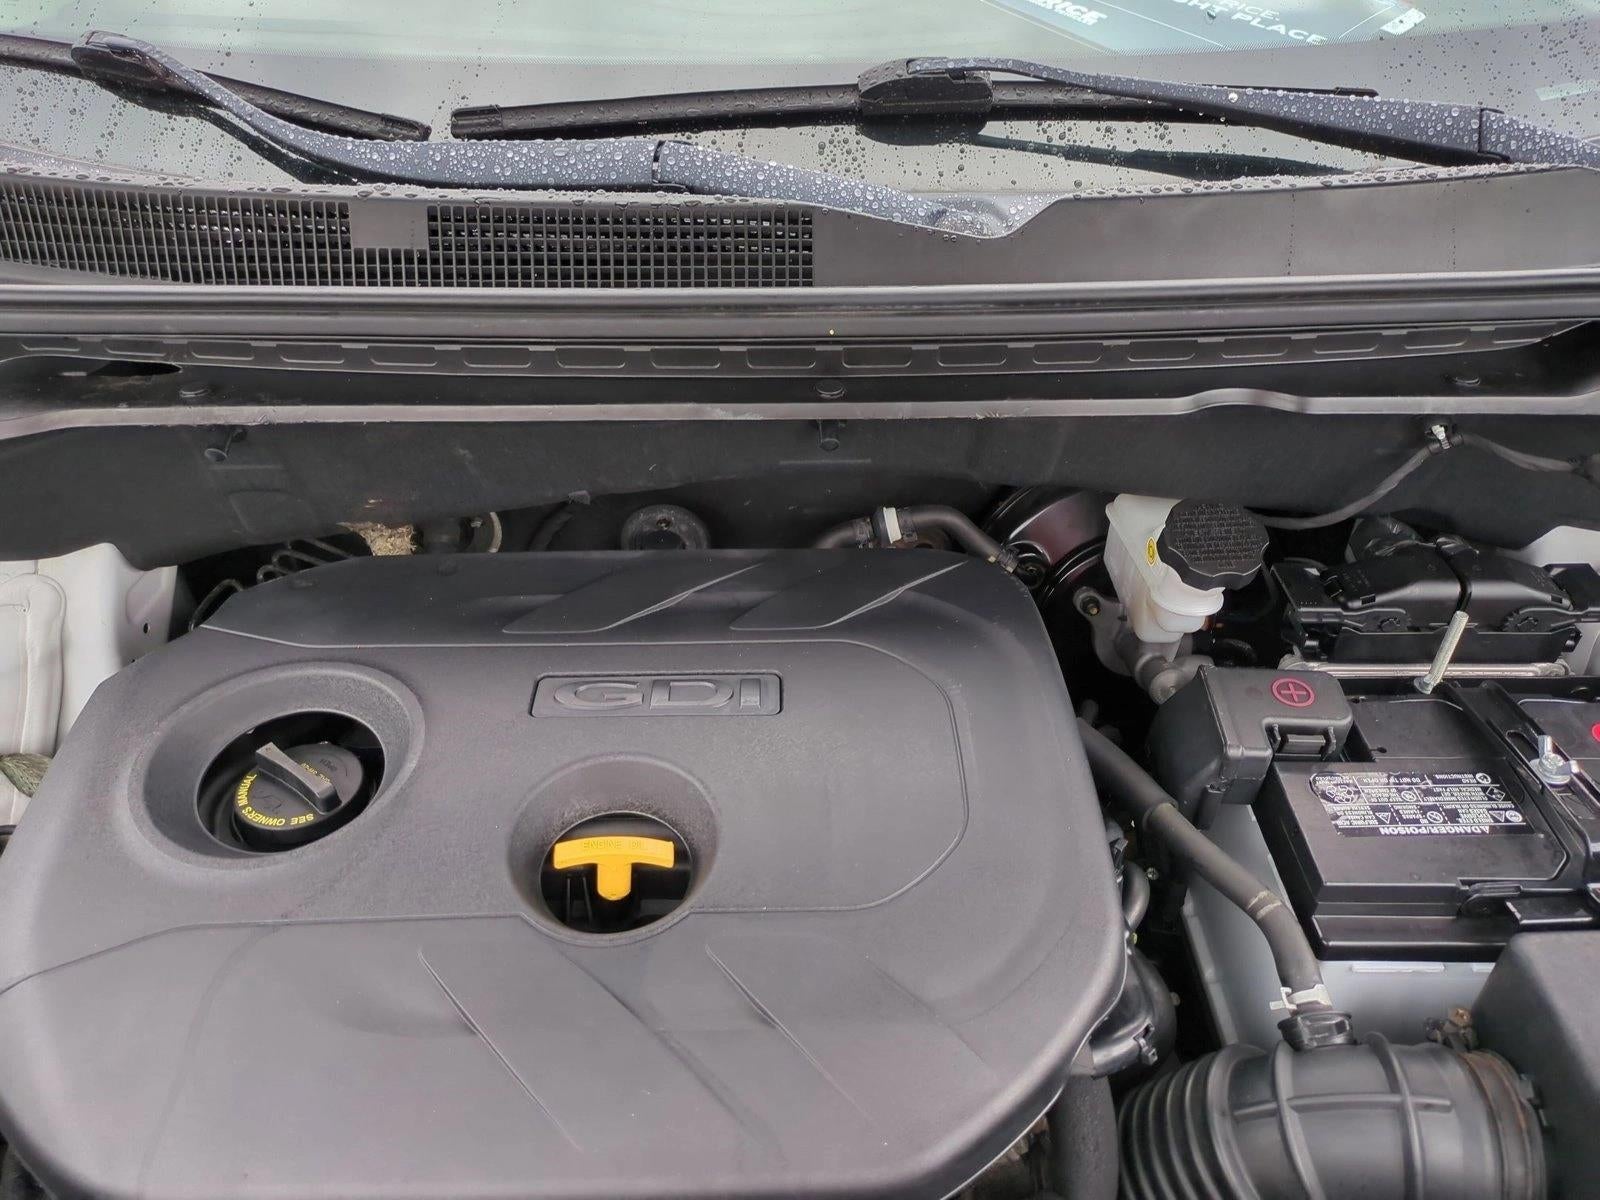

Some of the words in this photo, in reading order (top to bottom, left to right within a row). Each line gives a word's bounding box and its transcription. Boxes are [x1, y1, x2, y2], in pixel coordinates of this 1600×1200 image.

[1027, 0, 1108, 25] RICE
[1231, 12, 1328, 46] PLACE
[554, 678, 761, 711] GDI
[237, 773, 258, 807] MANUAL
[241, 806, 286, 827] OWNER'S
[290, 813, 314, 825] SEE
[1379, 826, 1480, 834] DANGER/POISON
[583, 839, 622, 849] ENGINE
